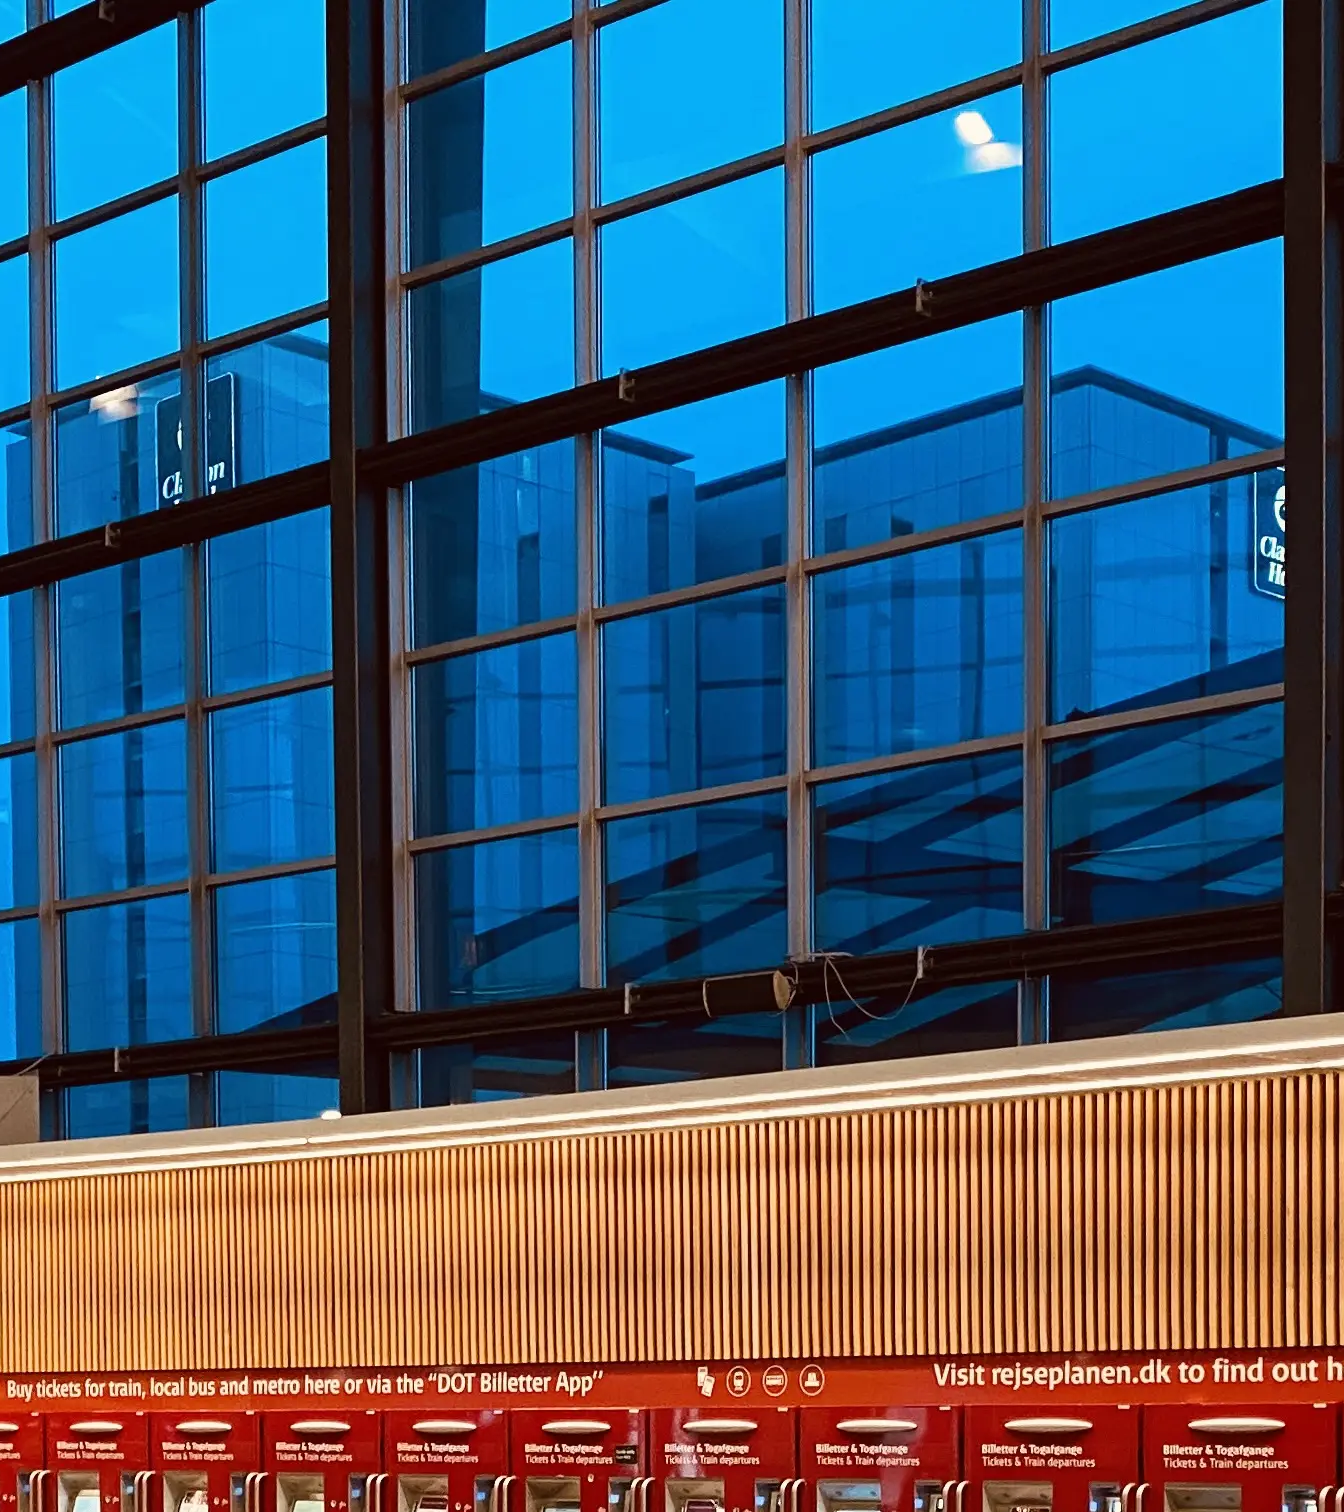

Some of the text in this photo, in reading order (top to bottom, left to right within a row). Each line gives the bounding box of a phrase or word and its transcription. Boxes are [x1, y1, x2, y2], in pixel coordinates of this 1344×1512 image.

[933, 1363, 985, 1386] Visit
[991, 1359, 1171, 1391] rejseplanen.dk
[1177, 1362, 1206, 1384] to
[1212, 1357, 1264, 1383] find
[1271, 1360, 1319, 1383] out
[7, 1380, 32, 1402] Buy
[36, 1378, 81, 1398] tickets
[85, 1379, 106, 1398] for
[109, 1379, 146, 1399] train,
[150, 1376, 185, 1397] local
[189, 1376, 216, 1396] bus
[220, 1376, 249, 1395] and
[253, 1376, 301, 1395] metro
[304, 1374, 341, 1395] here
[344, 1379, 364, 1395] or
[367, 1375, 392, 1394] via
[396, 1373, 424, 1394] the
[480, 1372, 552, 1393] Billetter
[1205, 1445, 1213, 1455] &
[1164, 1457, 1288, 1470] Tickets & Train departures
